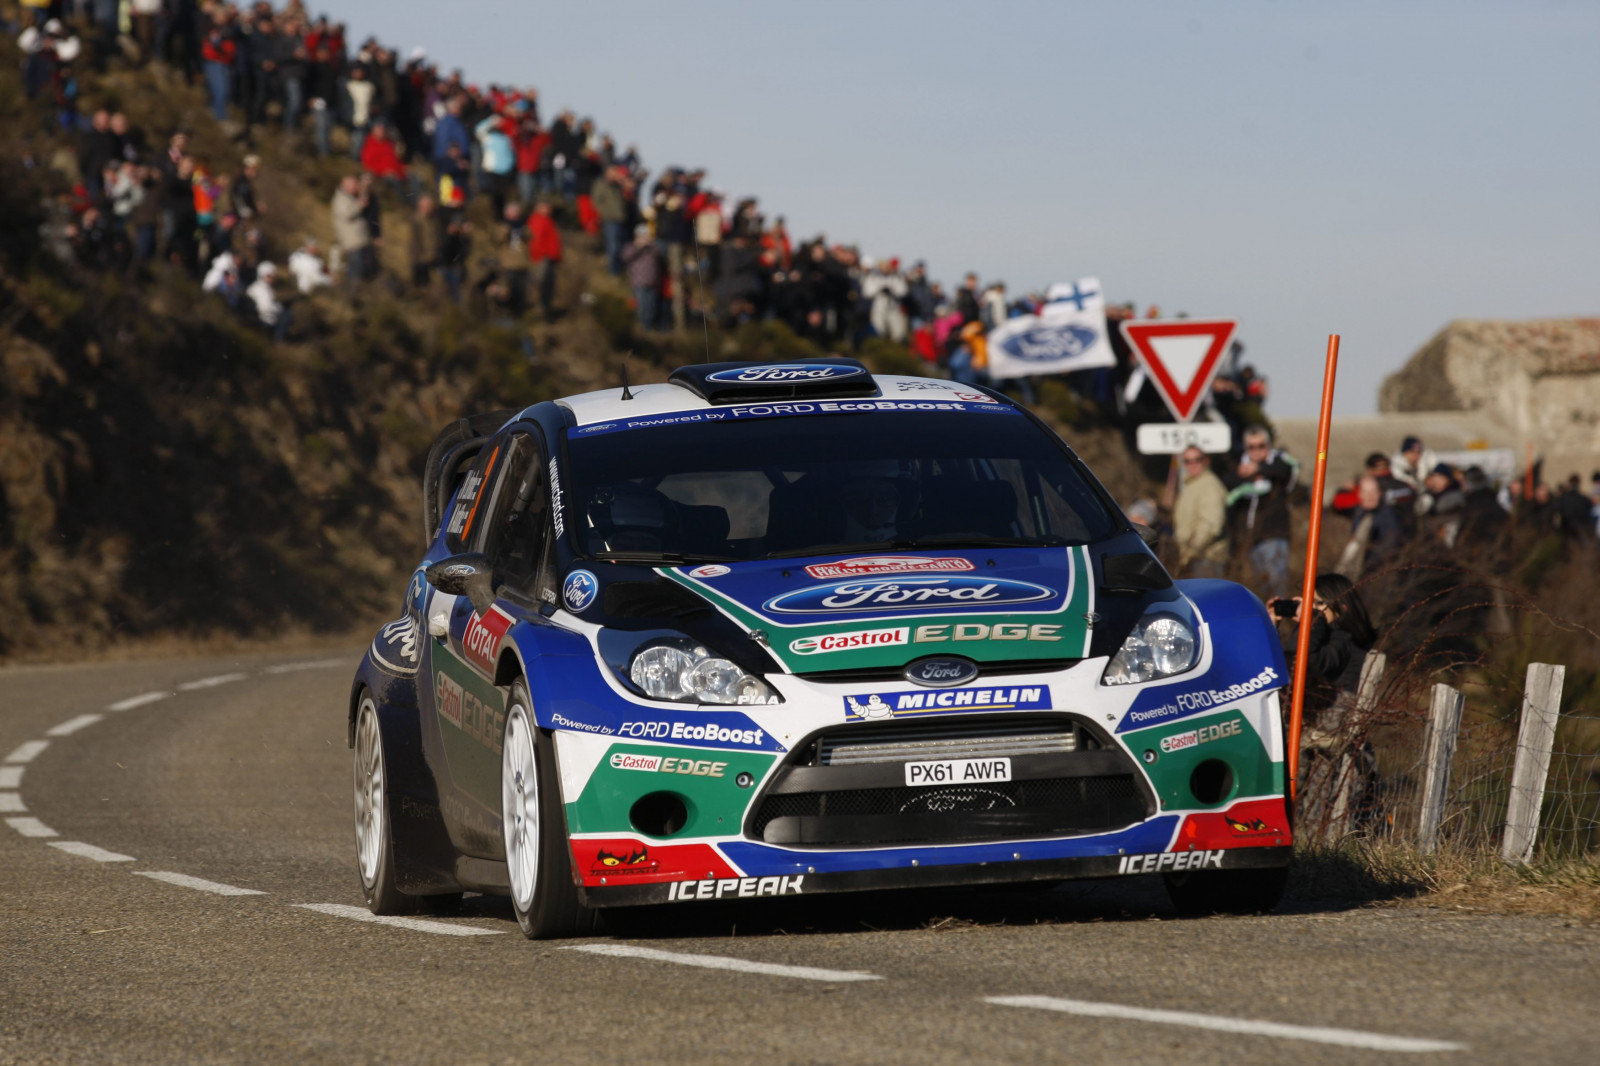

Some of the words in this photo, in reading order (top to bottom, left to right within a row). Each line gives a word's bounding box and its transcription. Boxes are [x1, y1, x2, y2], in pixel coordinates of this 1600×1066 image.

[737, 365, 834, 381] Ford
[627, 414, 701, 427] Powered
[705, 412, 726, 421] by
[732, 404, 814, 417] FORD
[819, 401, 966, 412] EcoBoost
[813, 564, 867, 577] RALLYE
[565, 574, 591, 607] Ford
[821, 579, 1000, 608] Ford
[467, 611, 495, 664] TOTAL
[820, 629, 903, 651] Castrol
[913, 623, 1064, 643] EDGE
[922, 662, 961, 679] Ford
[737, 695, 780, 704] PIAA
[897, 688, 1042, 710] MICHELIN
[1130, 704, 1169, 722] Powered
[1167, 703, 1179, 715] by
[1176, 691, 1213, 711] FORD
[1209, 666, 1279, 704] EcoBoost
[442, 679, 462, 723] Castrol
[463, 691, 504, 757] EDGE
[551, 713, 601, 733] Powered
[601, 725, 615, 735] by
[618, 721, 670, 738] FORD
[670, 722, 764, 745] EcoBoost
[1170, 733, 1197, 750] Castrol
[1197, 718, 1243, 744] EDGE
[622, 755, 658, 770] Castrol
[659, 757, 729, 778] EDGE
[911, 763, 953, 782] PX61
[964, 761, 1006, 780] AWR
[1118, 849, 1226, 875] ICEPEAK
[668, 875, 805, 901] ICEPEAK
